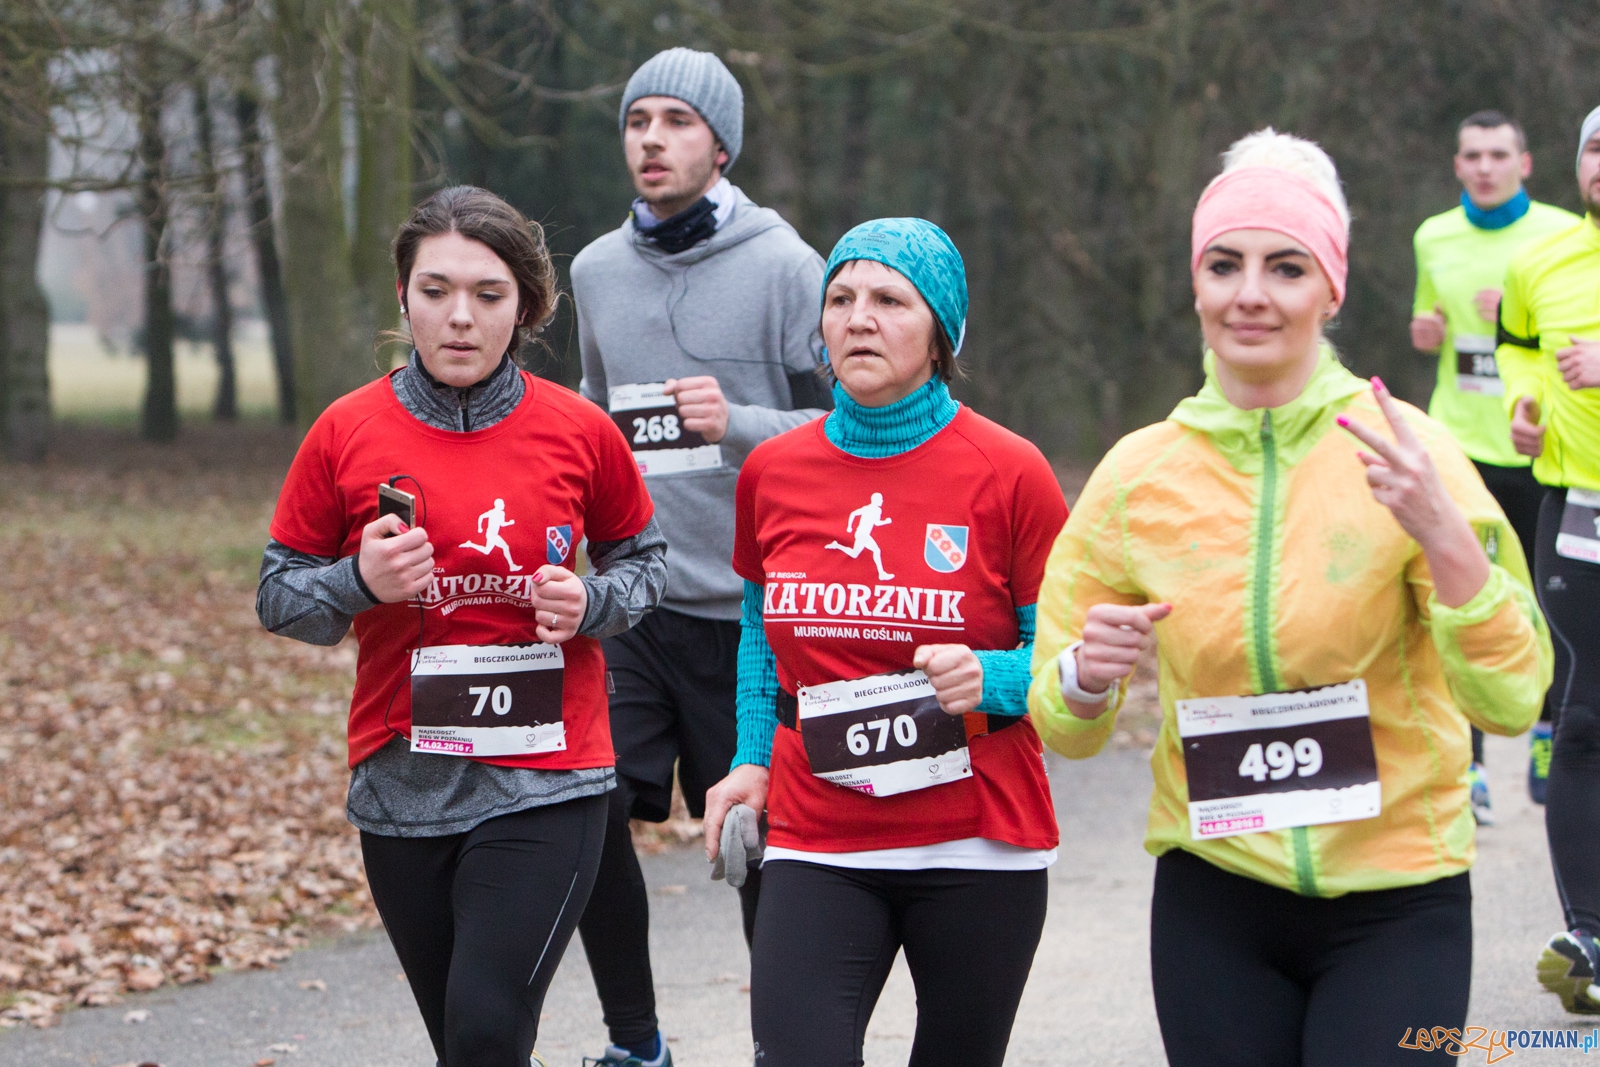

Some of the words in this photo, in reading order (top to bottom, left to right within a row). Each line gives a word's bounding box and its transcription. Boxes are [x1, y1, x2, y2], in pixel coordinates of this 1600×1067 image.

[632, 414, 681, 444] 268
[441, 596, 493, 616] MUROWANA
[793, 626, 861, 639] MUROWANA
[862, 627, 914, 643] GOŚLINA
[473, 652, 559, 664] BIEGCZEKOLADOWY.PL
[853, 678, 930, 699] BIEGCZEKOLADOW
[468, 685, 513, 716] 70
[419, 740, 465, 752] 14.02.2016
[845, 714, 919, 757] 670
[1238, 737, 1324, 783] 499
